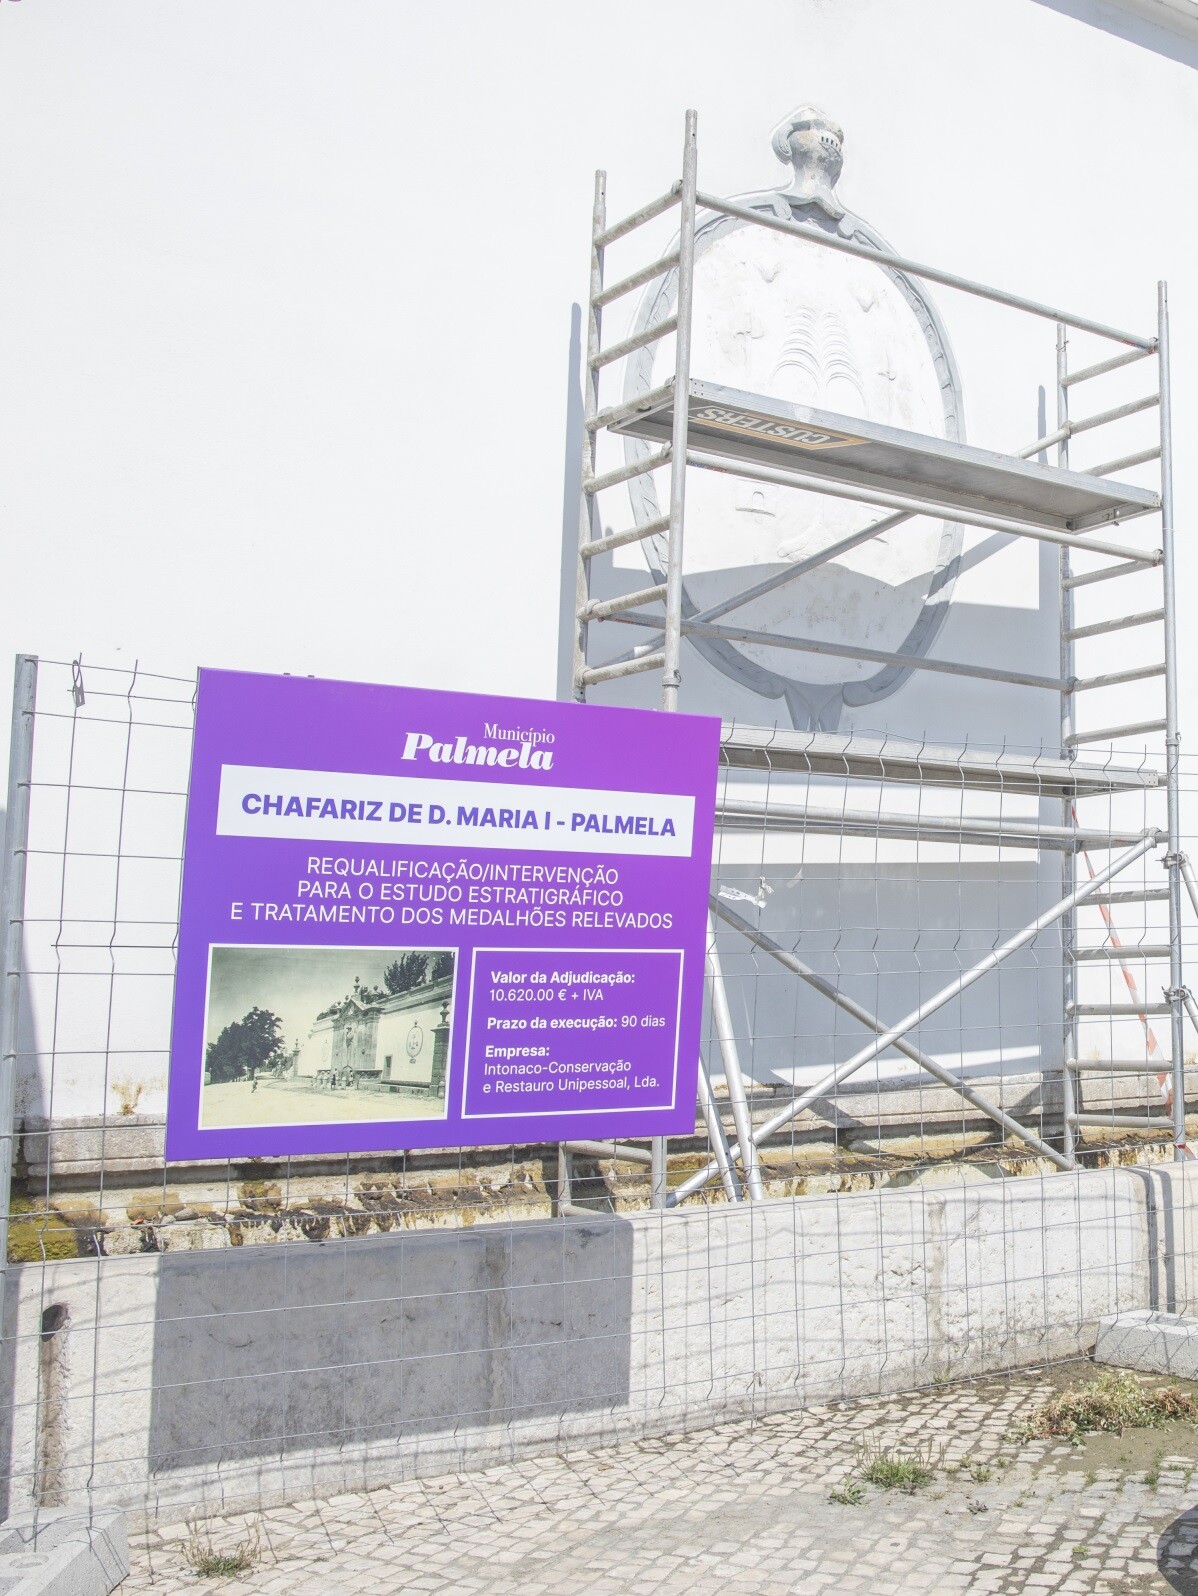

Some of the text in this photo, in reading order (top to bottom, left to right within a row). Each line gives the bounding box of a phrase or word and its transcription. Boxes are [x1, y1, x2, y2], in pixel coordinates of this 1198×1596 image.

[697, 407, 831, 445] CUSTERS
[482, 723, 556, 746] Município
[401, 731, 554, 771] Palmela
[242, 793, 384, 822] CHAFARIZ
[388, 802, 423, 824] DE
[429, 805, 452, 826] D.
[457, 807, 539, 830] MARIA
[544, 811, 552, 831] I
[572, 812, 676, 837] PALMELA
[307, 856, 619, 886] REQUALIFICAÇÃO/INTERVENÇÃO
[297, 880, 624, 908] PARA O ESTUDO ESTRATIGRÁFICO
[231, 902, 673, 929] E TRATAMENTO DOS MEDALHÕES RELEVADOS
[490, 970, 636, 987] Valor da Adjudicação:
[489, 988, 604, 1002] 10.620.00 € + IVA
[487, 1014, 666, 1031] Prazo da execução: 90 dias
[485, 1045, 550, 1060] Empresa:
[484, 1059, 632, 1076] Intonaco-Conservação
[483, 1075, 660, 1094] e Restauro Unipessoal, Lda.
